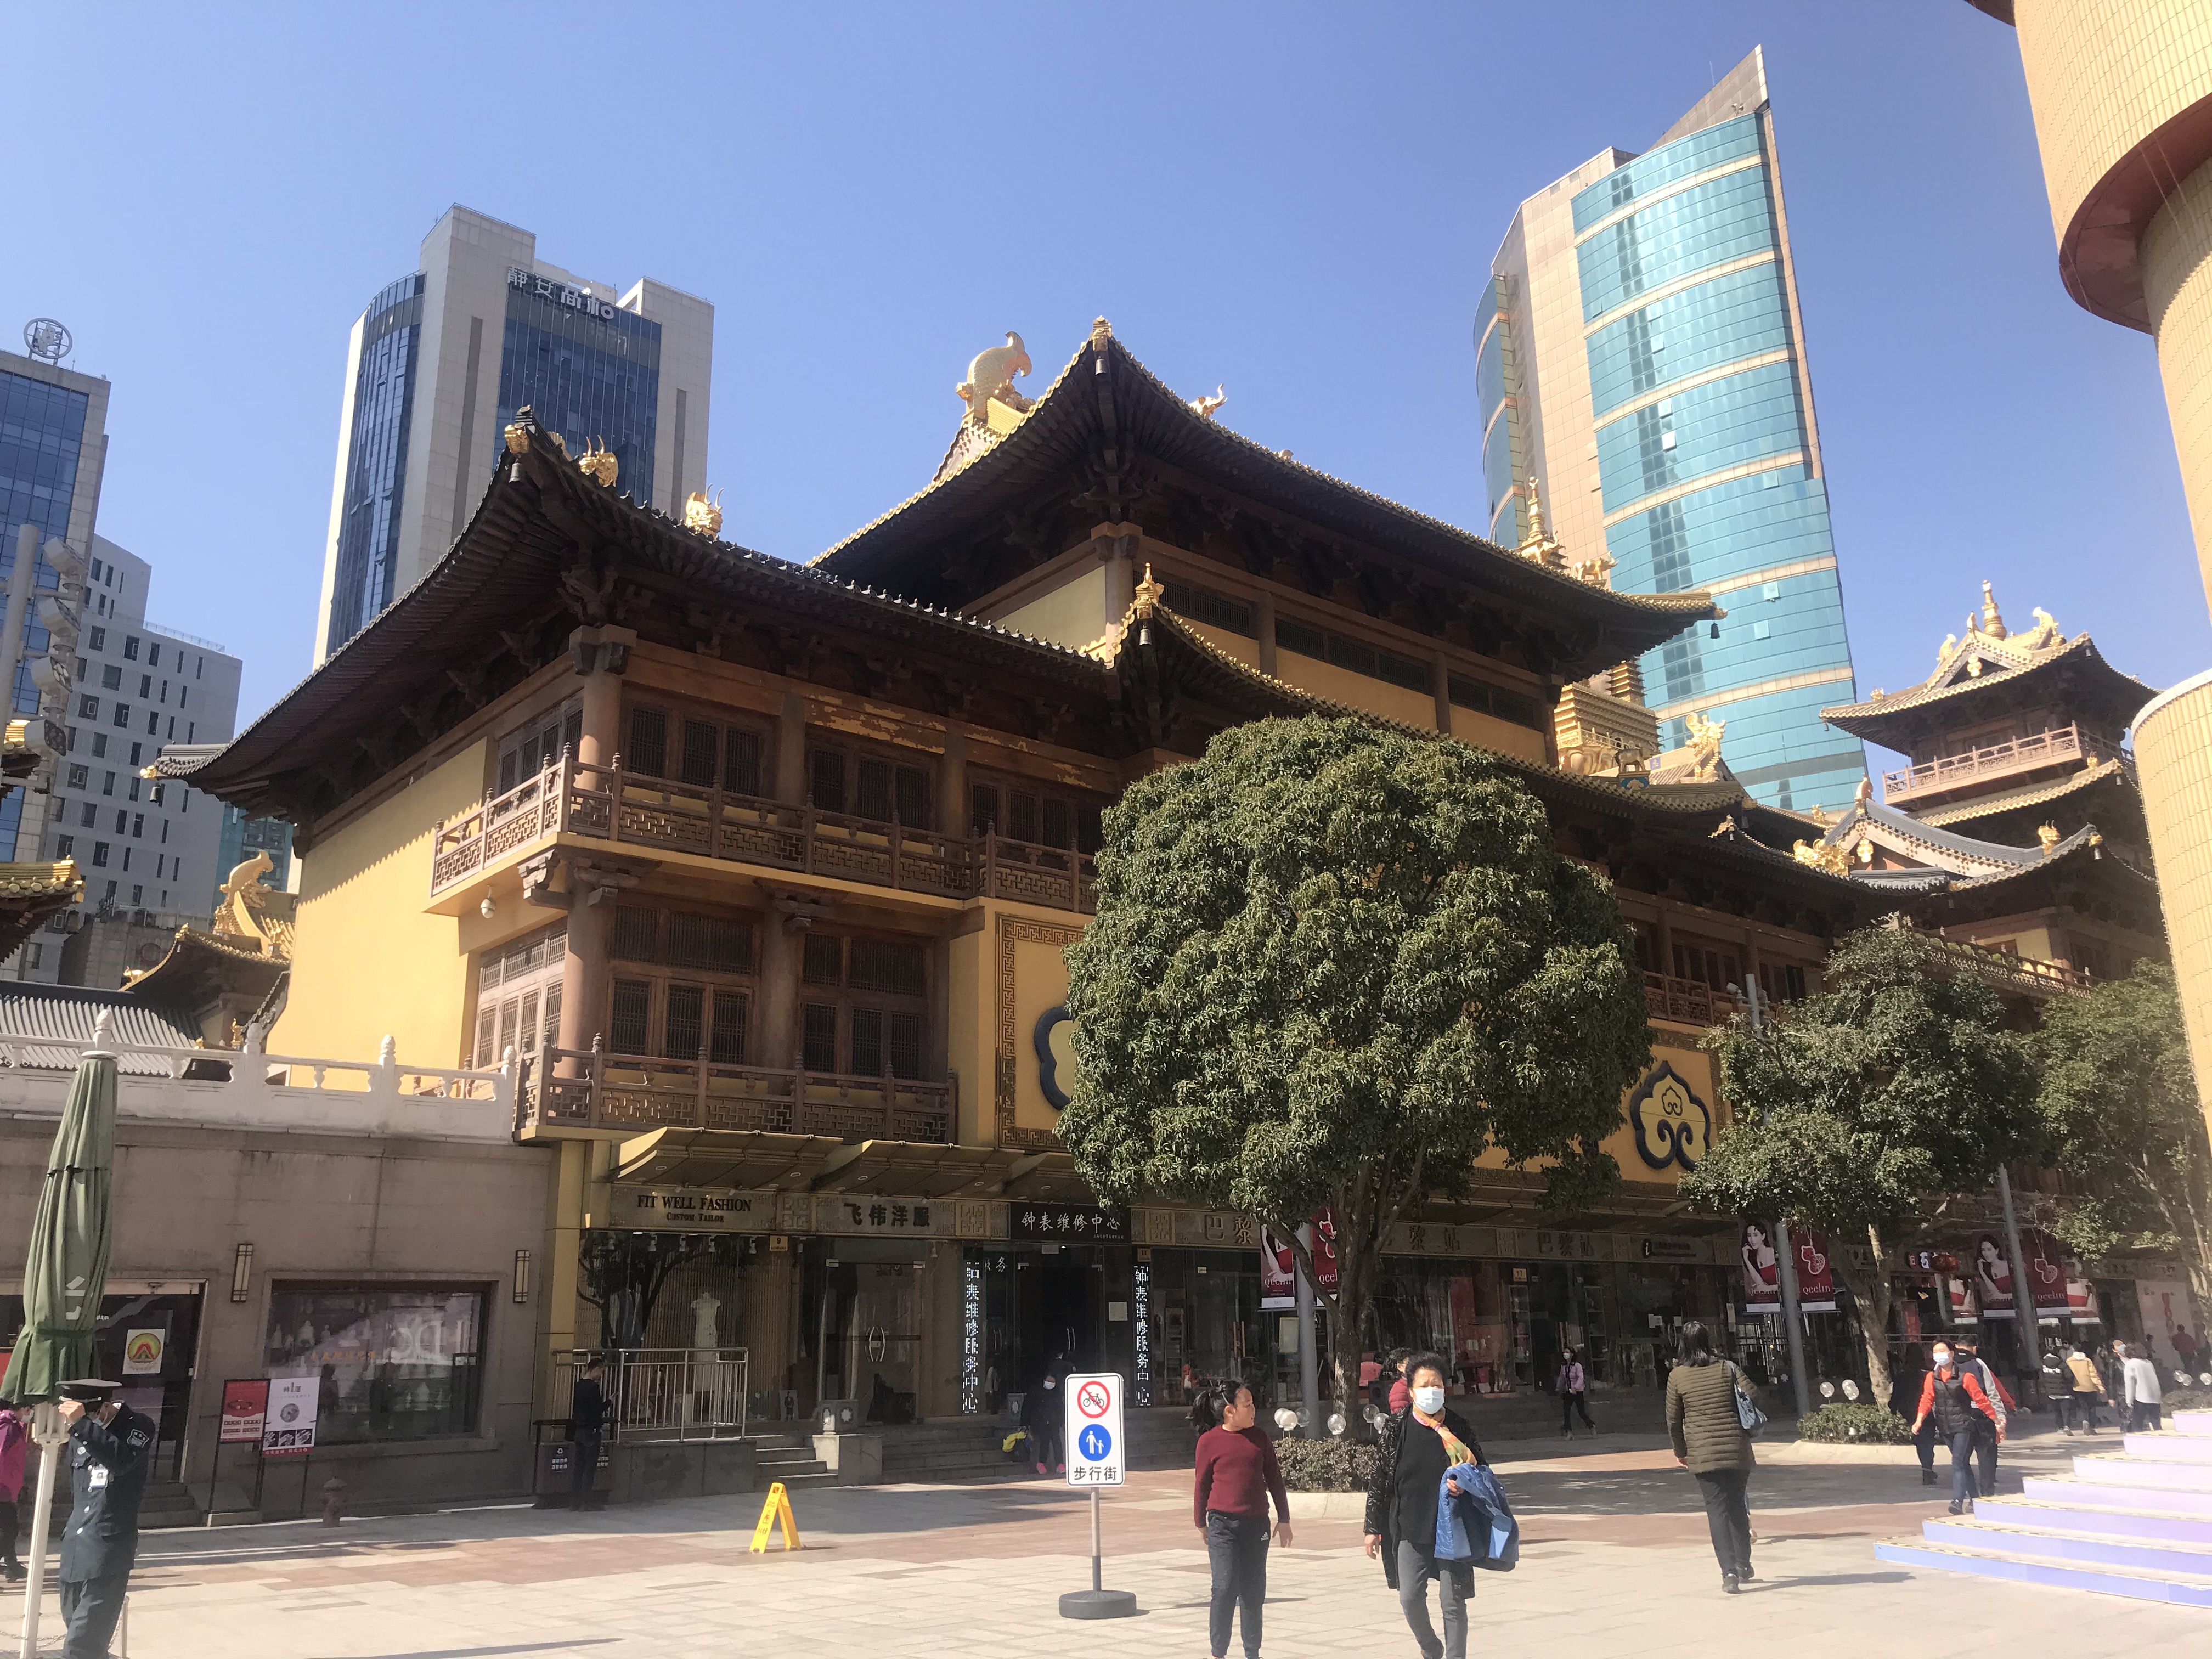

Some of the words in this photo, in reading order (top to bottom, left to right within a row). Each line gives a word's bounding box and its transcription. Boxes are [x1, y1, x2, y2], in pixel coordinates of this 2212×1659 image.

[637, 1195, 657, 1208] FIT
[662, 1196, 696, 1209] WELL
[699, 1198, 752, 1211] FASHION
[844, 1203, 930, 1227] 飞伟洋服
[1021, 1211, 1120, 1233] 钟表维修中心
[1205, 1215, 1253, 1244] 巴黎
[1388, 1225, 1460, 1251] 黎站
[1319, 1268, 1338, 1285] Qeel
[1074, 1466, 1117, 1481] 步行街
